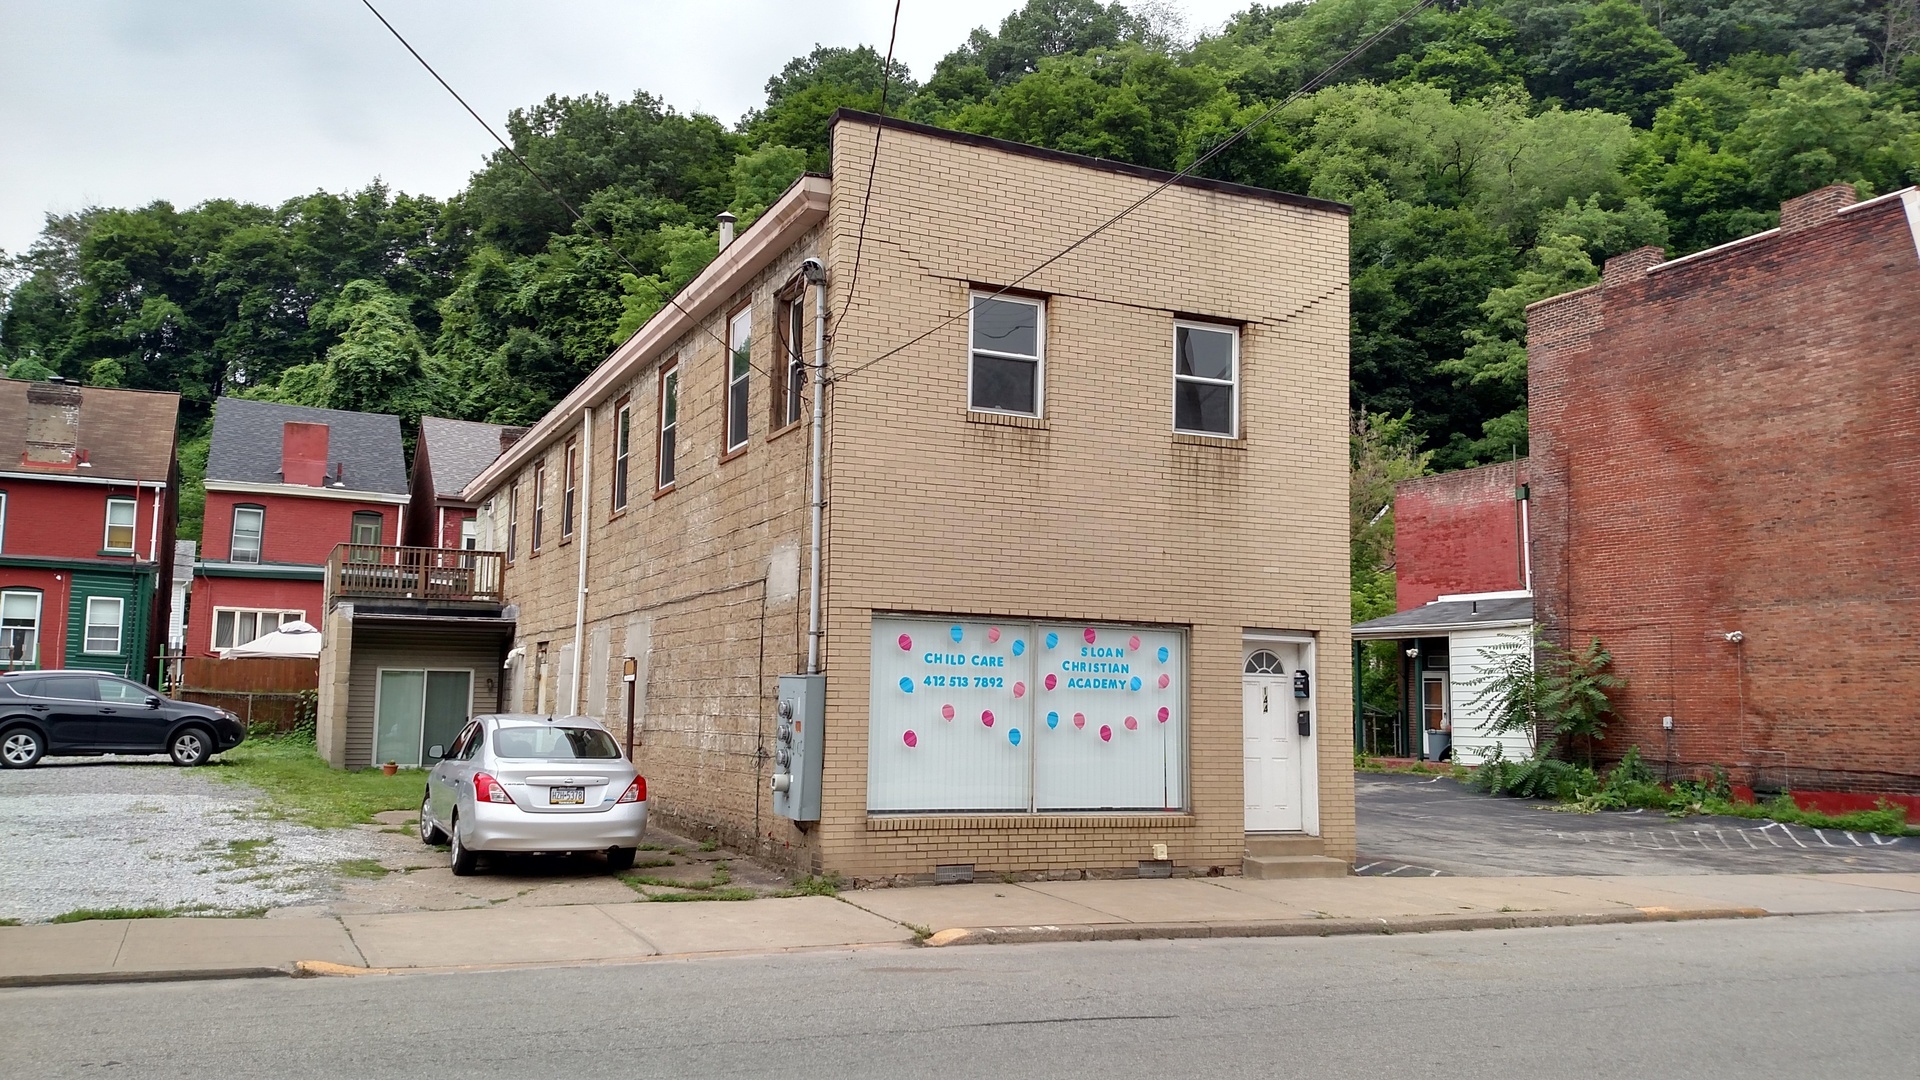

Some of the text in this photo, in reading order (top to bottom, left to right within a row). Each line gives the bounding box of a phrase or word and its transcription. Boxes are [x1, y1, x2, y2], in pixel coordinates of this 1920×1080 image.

[1081, 646, 1124, 658] SLOAN
[924, 652, 1004, 667] CHILD CARE
[1062, 660, 1129, 674] CHRISTIAN
[923, 675, 1003, 688] 412 513 7892
[1067, 677, 1127, 690] ACADEMY
